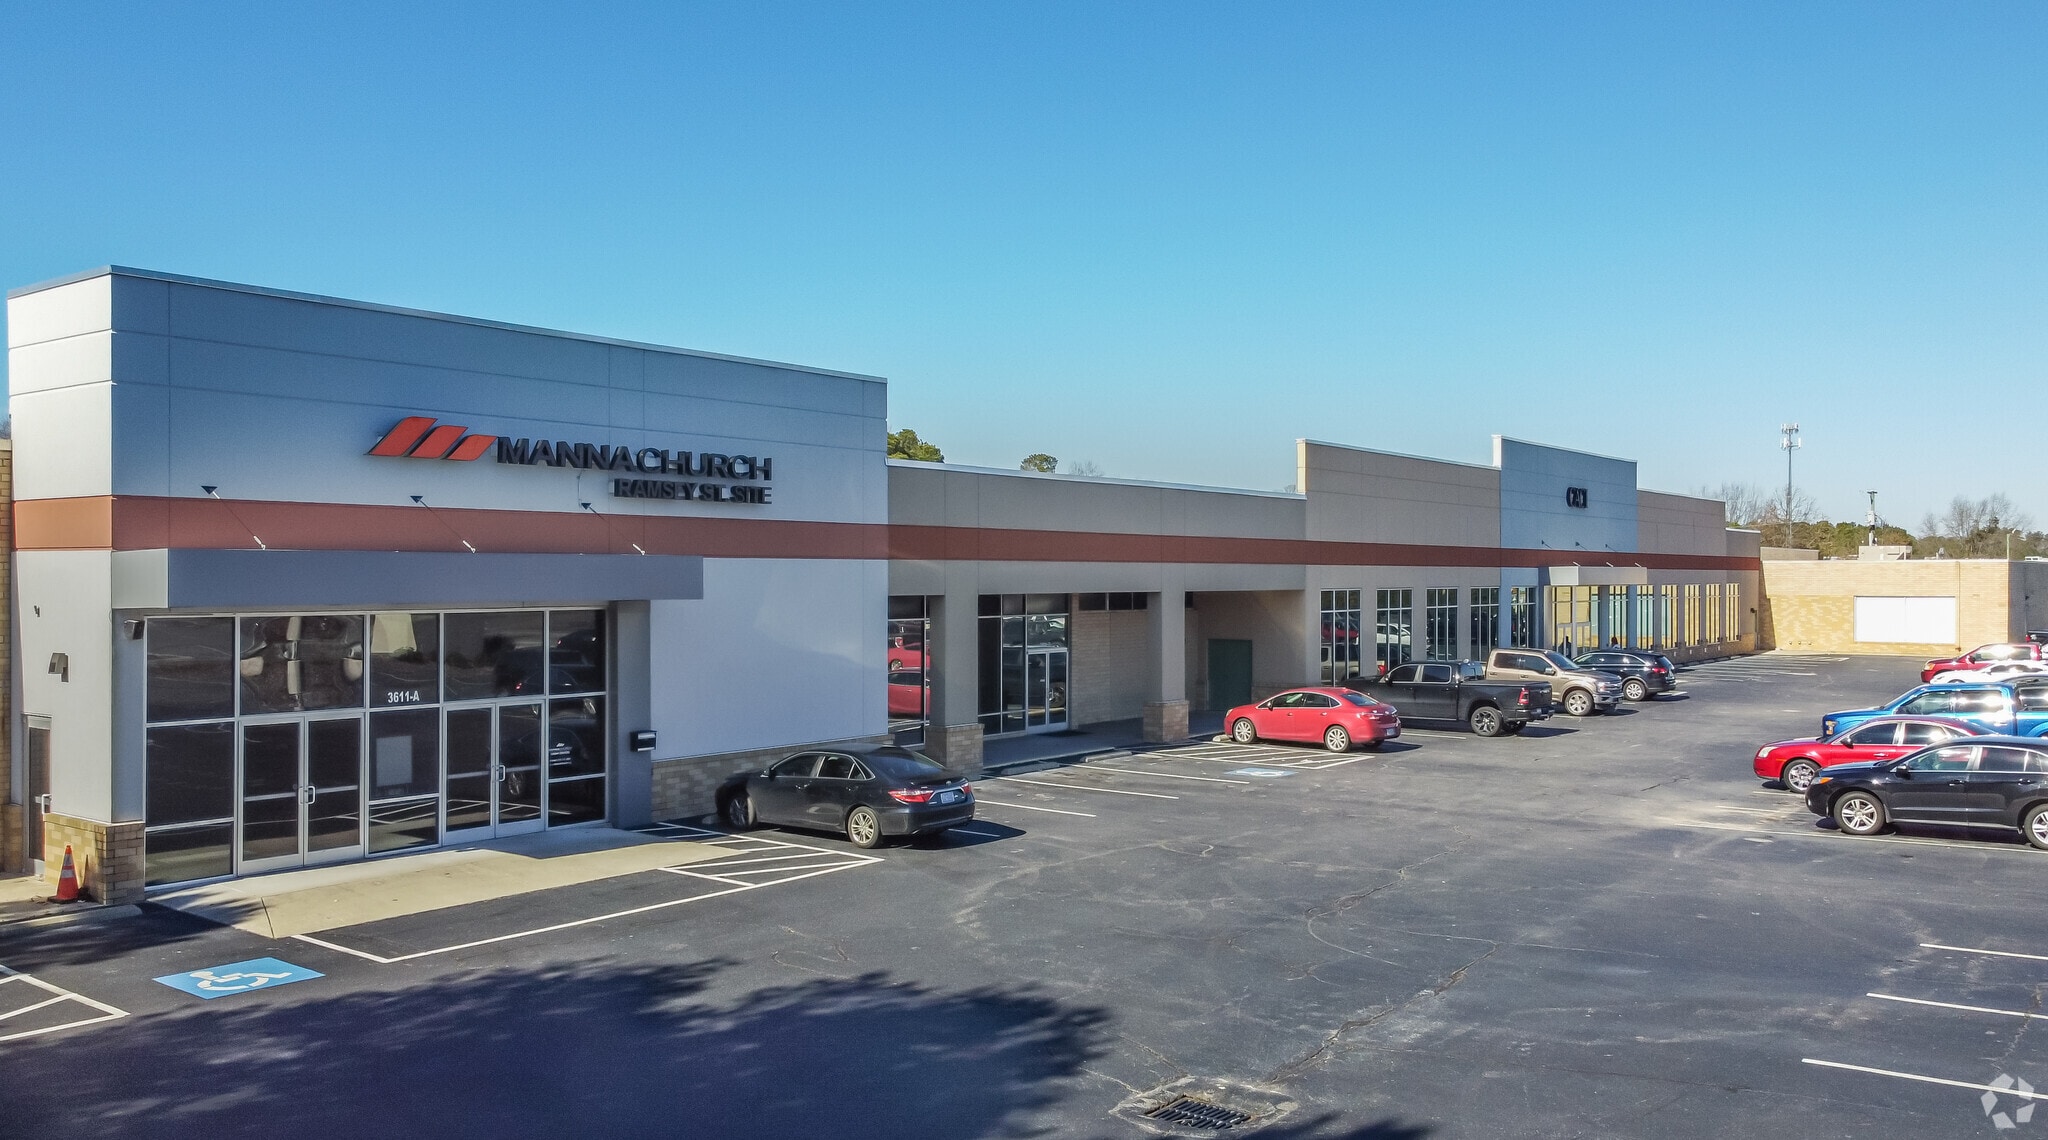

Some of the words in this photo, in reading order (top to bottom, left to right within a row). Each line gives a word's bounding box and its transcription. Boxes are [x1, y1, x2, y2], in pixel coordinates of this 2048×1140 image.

[614, 478, 698, 501] RAMSEY
[731, 485, 773, 505] SITE
[387, 690, 420, 703] 3611-A
